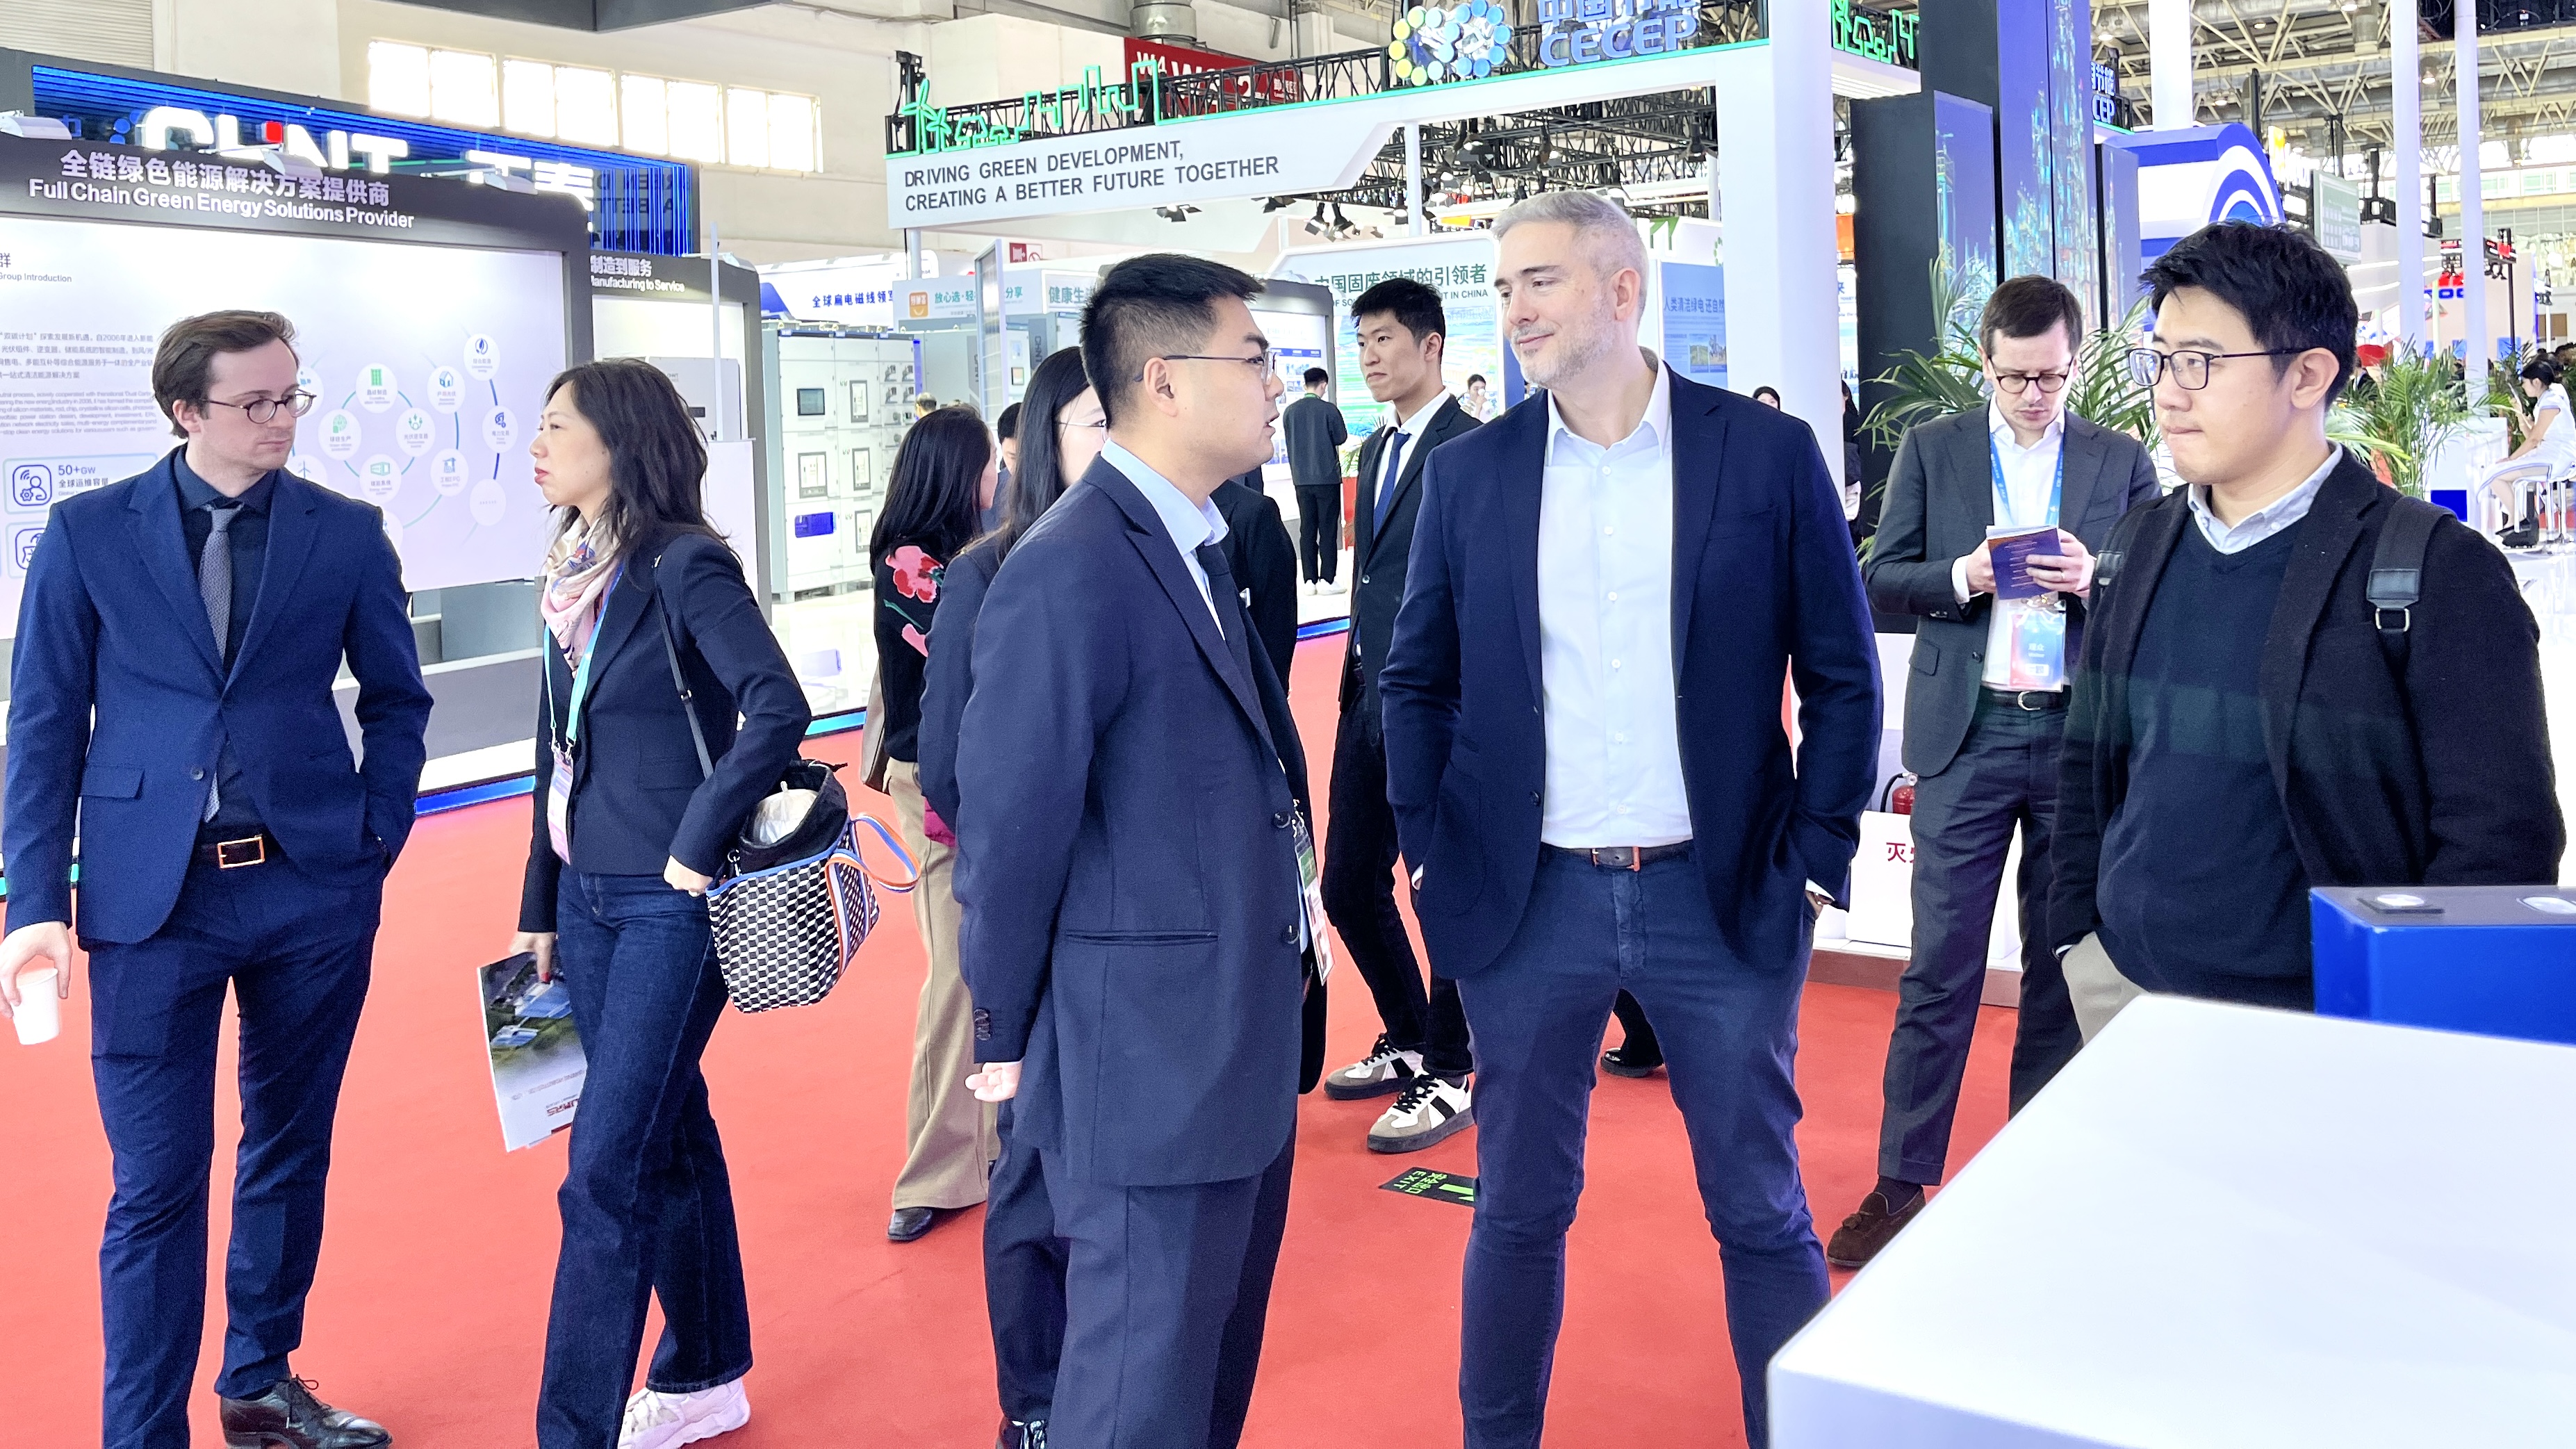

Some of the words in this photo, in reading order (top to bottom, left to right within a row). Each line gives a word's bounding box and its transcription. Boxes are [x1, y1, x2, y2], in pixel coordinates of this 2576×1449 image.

[1539, 14, 1697, 67] CECEP
[60, 149, 389, 206] 全链绿色能源解决方案提供商
[905, 164, 970, 187] DRIVING
[979, 156, 1037, 179] GREEN
[1047, 140, 1183, 172] DEVELOPMENT,
[905, 188, 986, 211] CREATING
[995, 186, 1008, 203] A
[1016, 177, 1083, 200] BETTER
[1093, 168, 1165, 192] FUTURE
[1174, 156, 1279, 183] TOGETHER
[29, 179, 68, 199] Full
[71, 182, 131, 205] Chain
[133, 188, 194, 210] Green
[197, 193, 262, 219] Energy
[264, 199, 344, 222] Solutions
[345, 206, 415, 228] Provider
[24, 272, 72, 282] Introduction
[590, 254, 652, 277] 制造到服务
[646, 279, 654, 290] to
[654, 279, 685, 293] Service
[1451, 290, 1459, 300] IN
[1461, 289, 1488, 298] CHINA
[1394, 1170, 1427, 1189] EXIT
